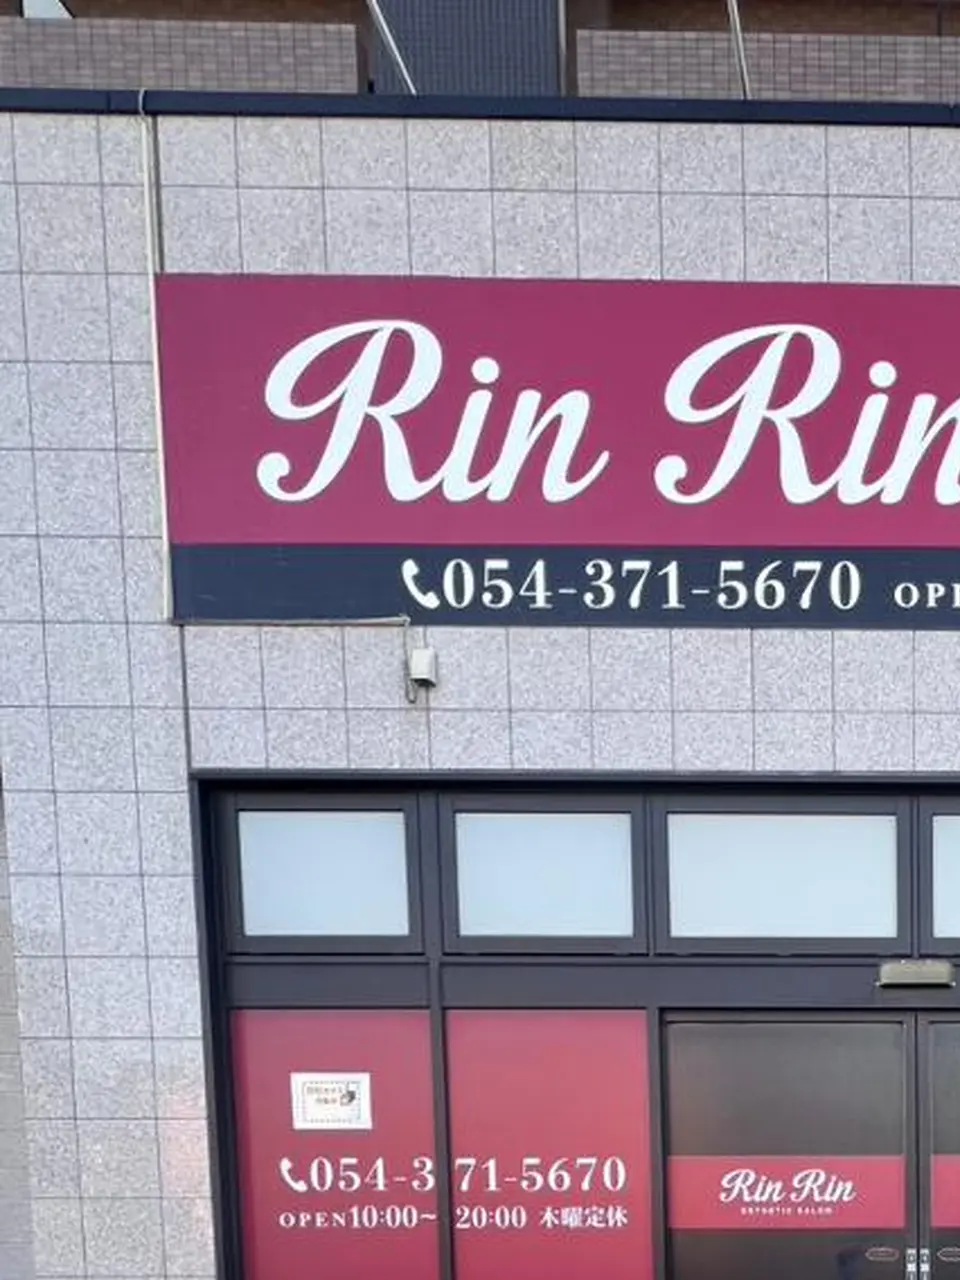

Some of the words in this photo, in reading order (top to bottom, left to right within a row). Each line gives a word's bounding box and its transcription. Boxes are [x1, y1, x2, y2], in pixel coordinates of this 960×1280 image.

[256, 319, 609, 502] Rin
[442, 558, 862, 611] 054-371-5670
[719, 1168, 785, 1203] Rin
[790, 1168, 856, 1203] Rin
[539, 1206, 628, 1230] 木曜定休
